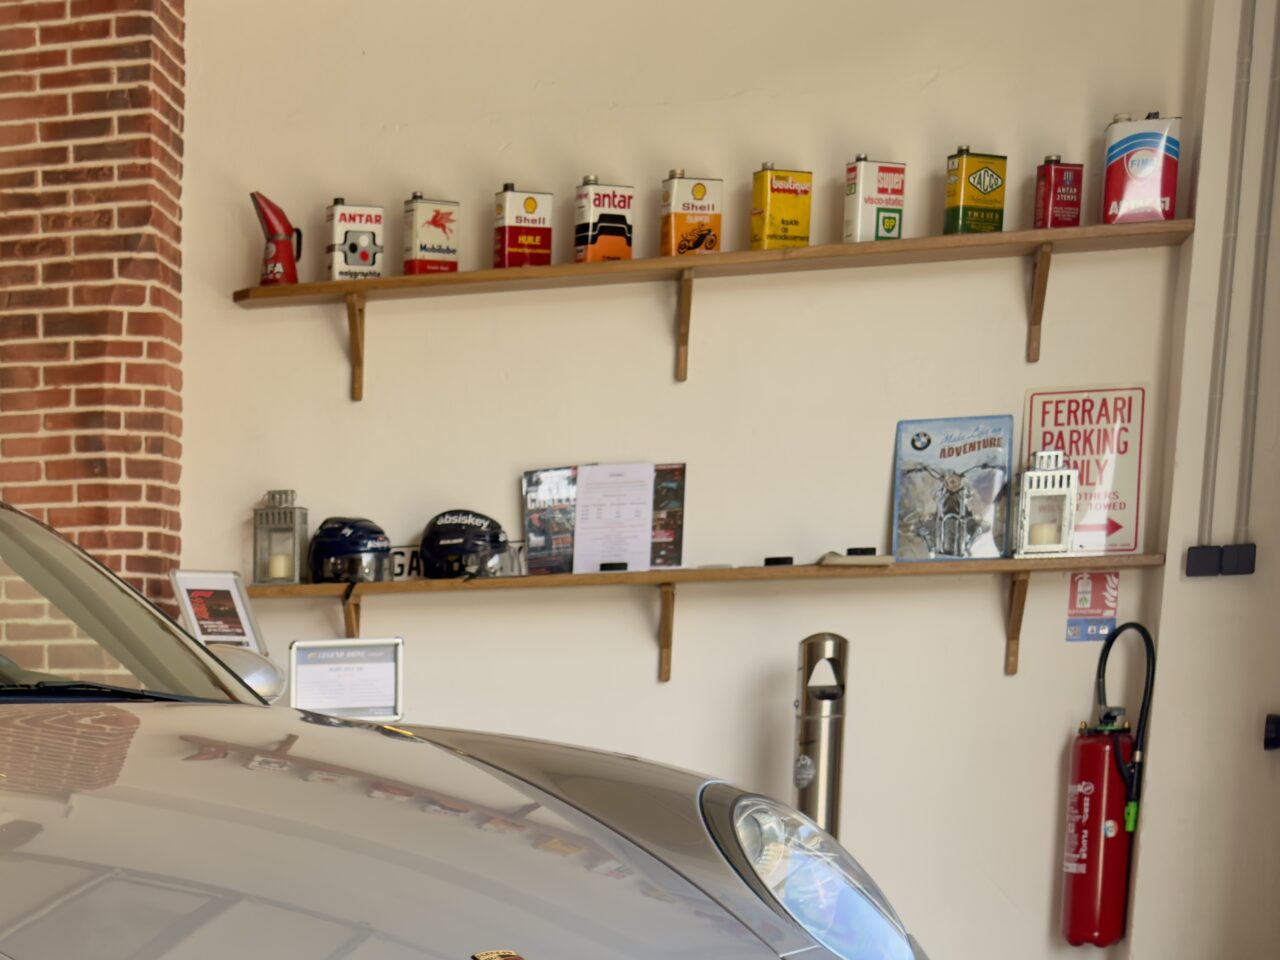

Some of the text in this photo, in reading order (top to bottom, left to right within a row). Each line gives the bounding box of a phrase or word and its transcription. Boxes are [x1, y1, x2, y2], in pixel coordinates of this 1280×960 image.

[878, 172, 904, 193] super
[972, 169, 999, 193] YACCO
[593, 191, 633, 209] antar
[682, 203, 715, 212] Shell
[338, 212, 382, 224] ANTAR
[515, 215, 546, 225] Shell
[884, 218, 896, 229] BP
[420, 243, 456, 255] Mobilube
[1041, 396, 1133, 428] FERRARI
[939, 437, 1003, 459] ADVENTURE
[1042, 427, 1129, 457] PARKING
[1088, 502, 1126, 511] TOWED
[436, 513, 490, 531] absiskey
